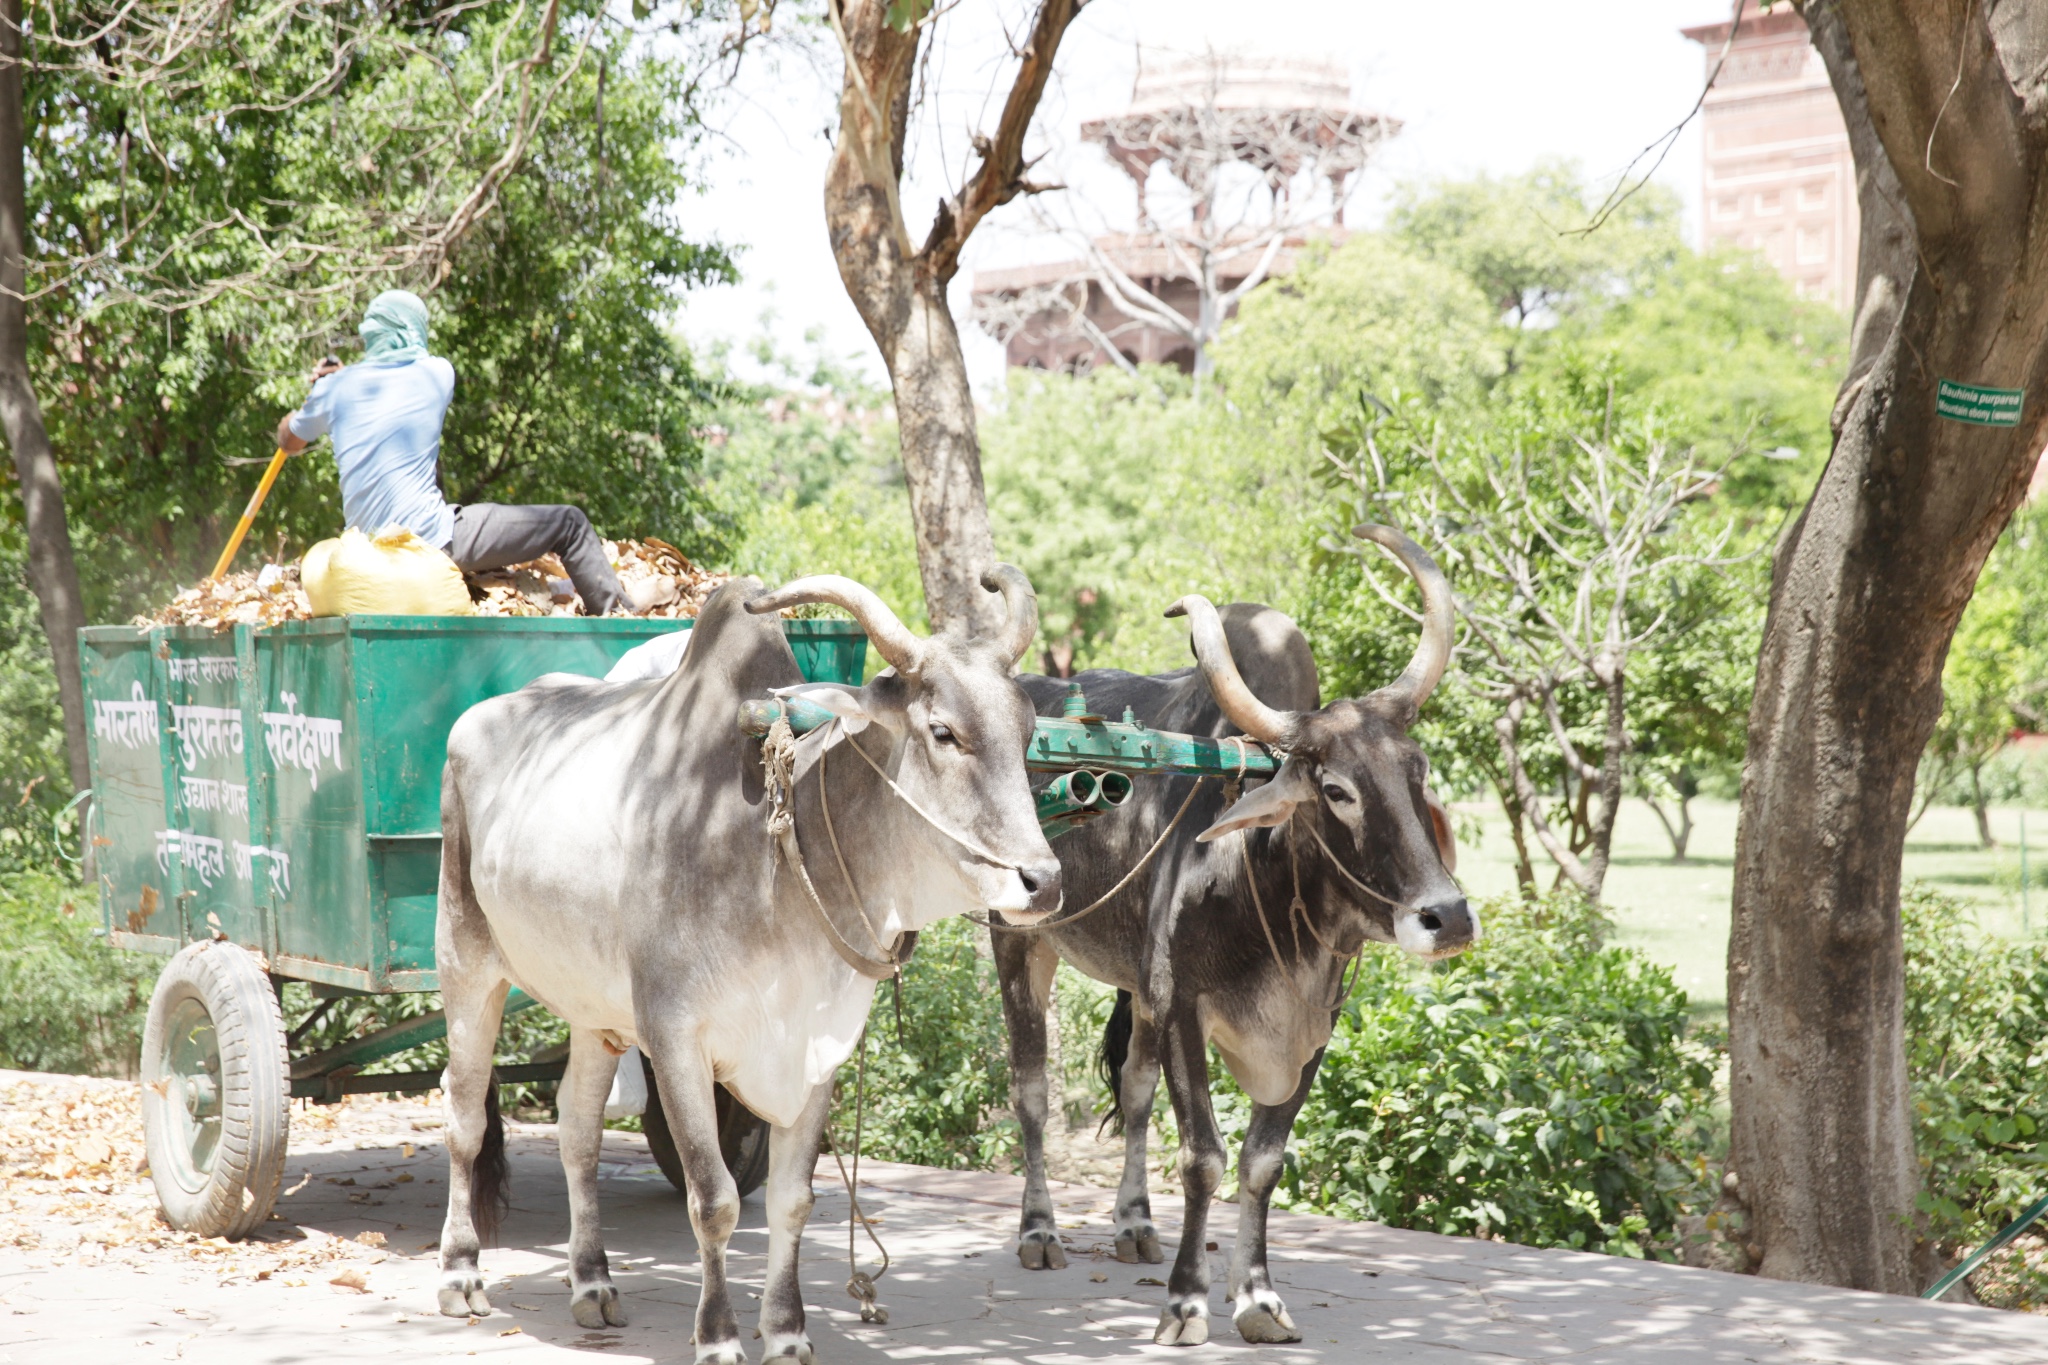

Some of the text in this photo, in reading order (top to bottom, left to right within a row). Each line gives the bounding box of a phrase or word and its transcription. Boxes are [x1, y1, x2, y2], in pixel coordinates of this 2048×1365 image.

[1940, 383, 1978, 402] Bauhinia
[1938, 399, 1969, 418] Mountain
[1968, 405, 1991, 422] ebony
[167, 656, 241, 686] भारत सरकार
[93, 680, 160, 749] भारतीय
[263, 690, 343, 792] सर्वेक्षण
[154, 829, 291, 901] तजमहल आरा
